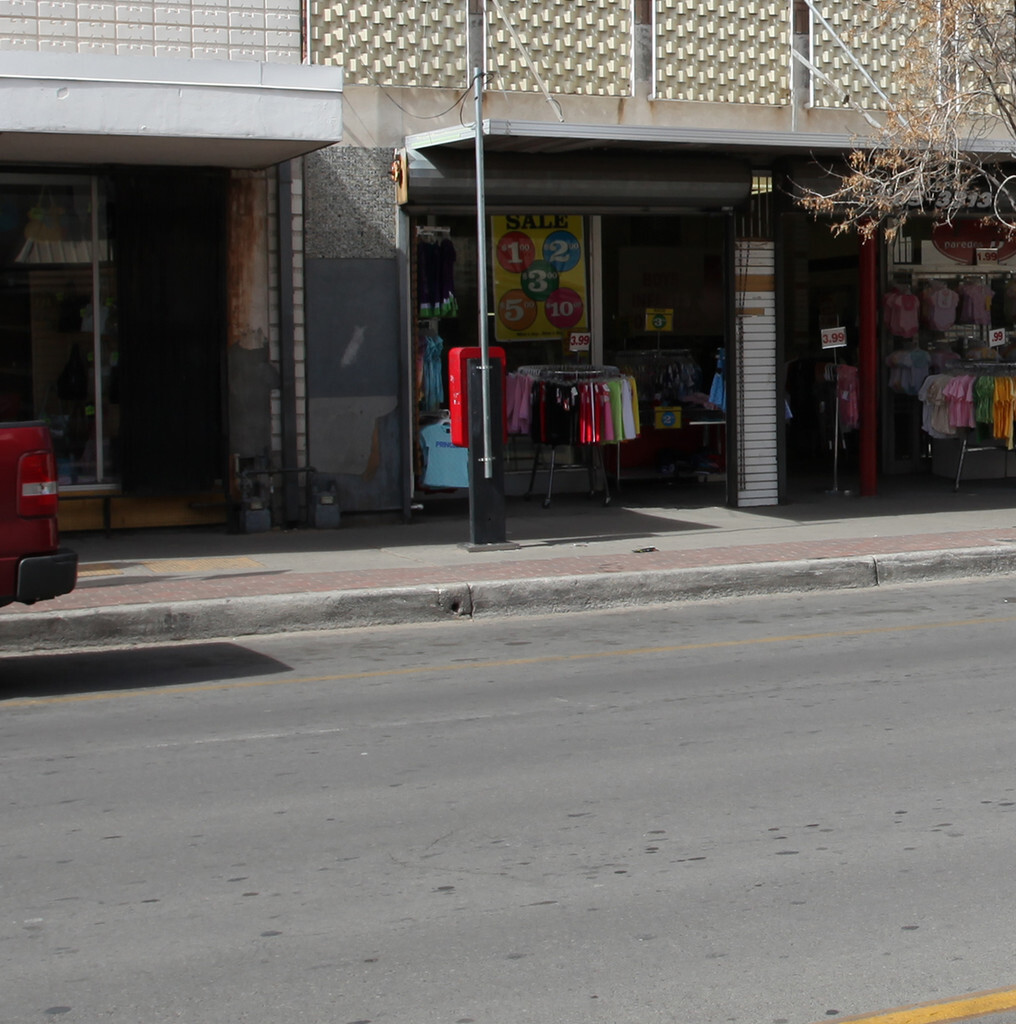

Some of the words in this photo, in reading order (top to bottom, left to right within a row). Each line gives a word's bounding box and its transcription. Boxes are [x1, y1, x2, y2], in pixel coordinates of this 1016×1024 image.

[506, 215, 568, 230] SALE
[977, 252, 998, 261] 1.99
[569, 335, 590, 346] 3.99
[822, 332, 845, 343] 3.99
